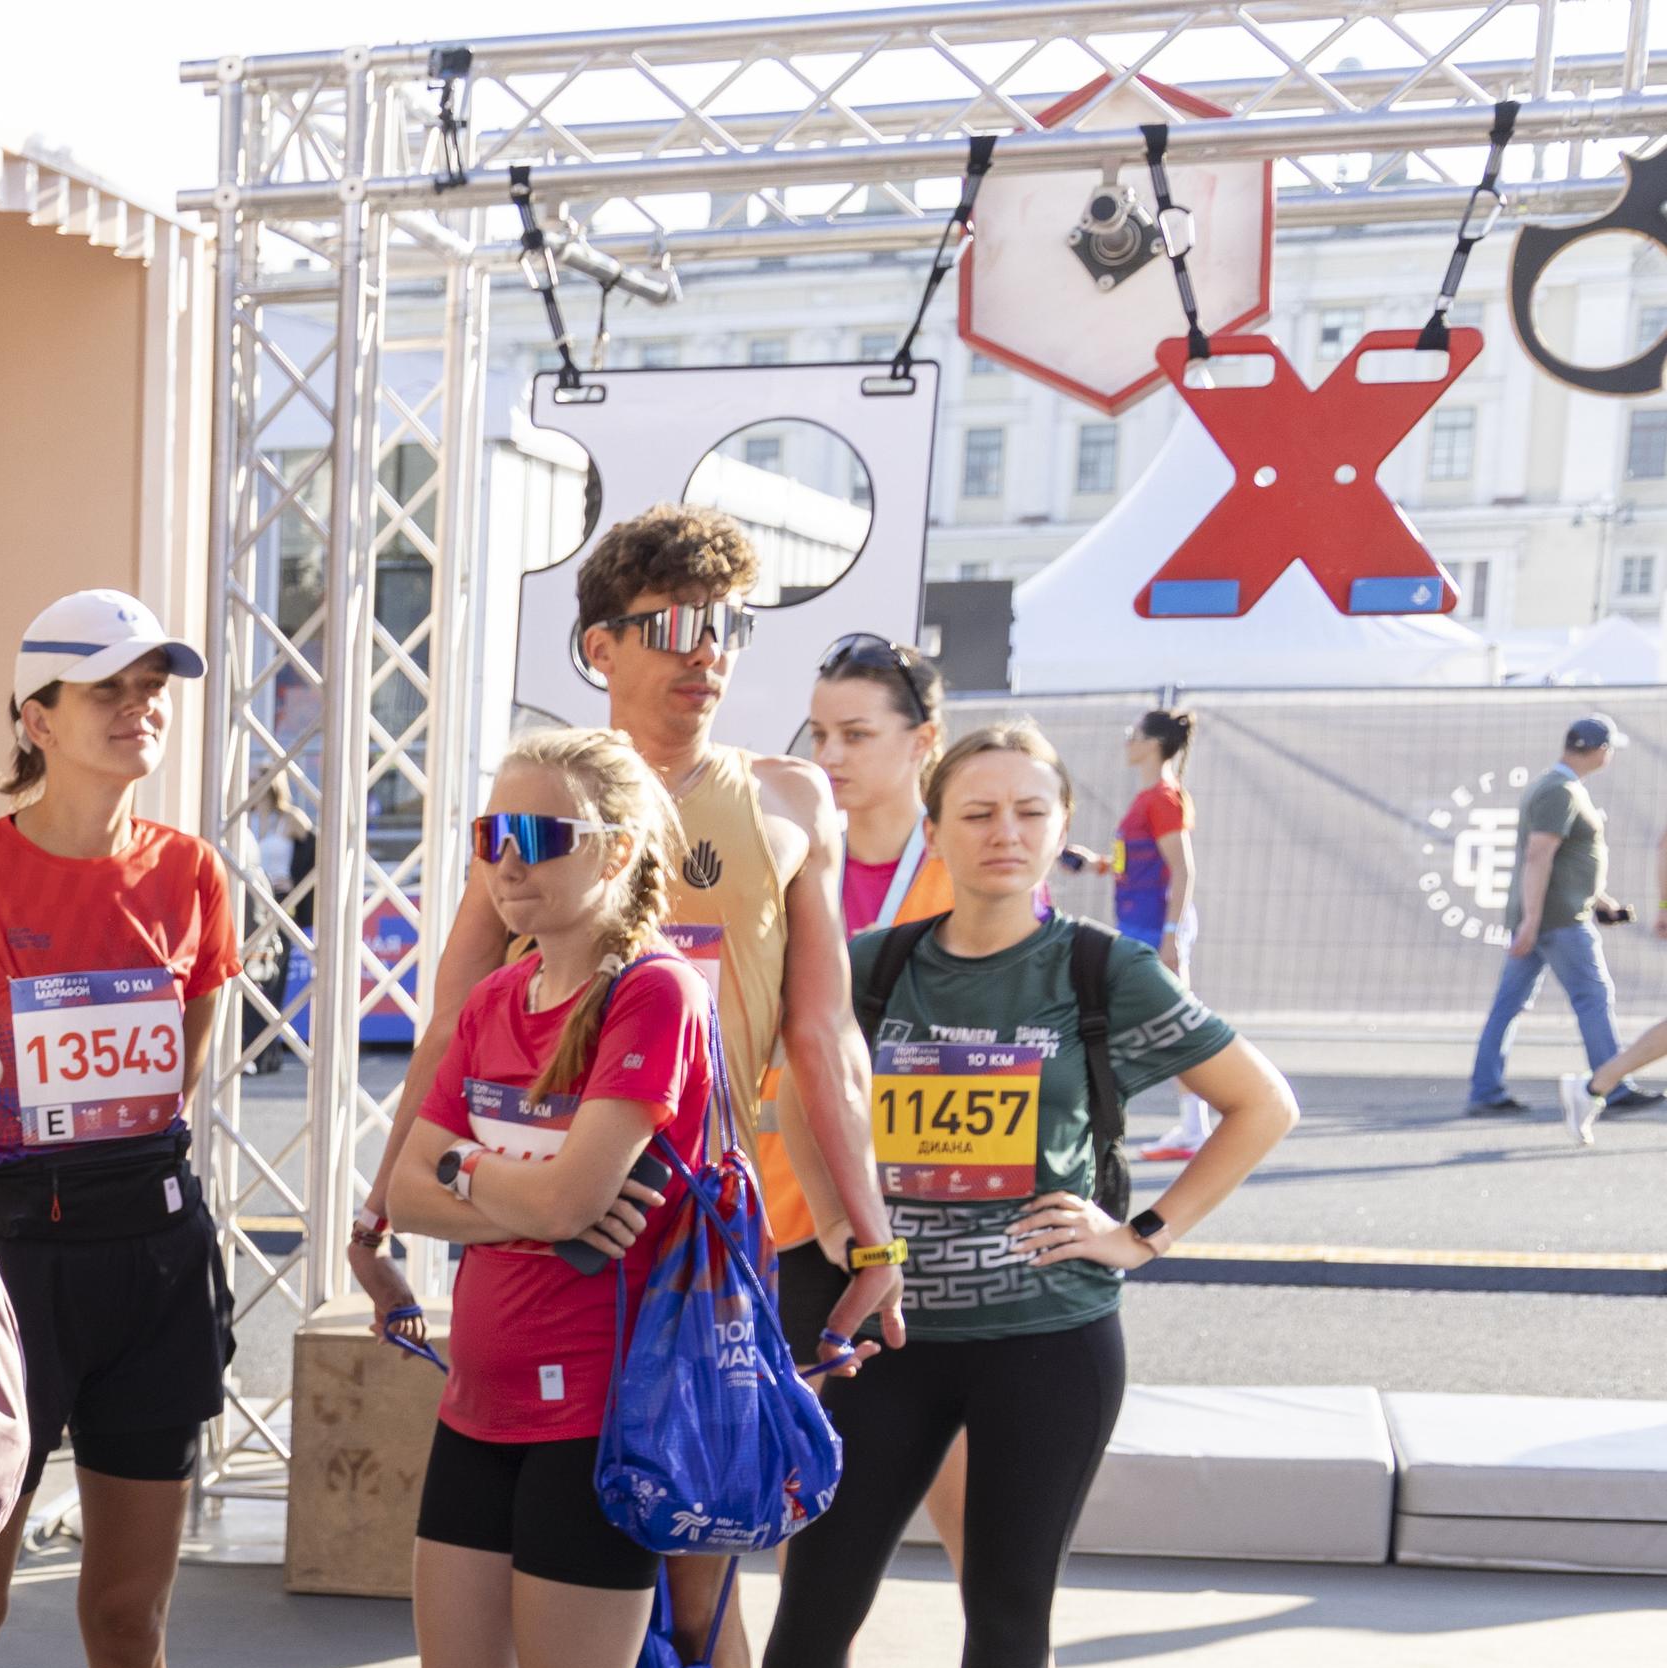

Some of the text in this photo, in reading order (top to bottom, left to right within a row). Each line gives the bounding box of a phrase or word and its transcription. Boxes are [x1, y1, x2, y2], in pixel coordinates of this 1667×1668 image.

[113, 979, 153, 994] 10 КМ
[929, 1024, 998, 1043] TYUMEN
[26, 1024, 178, 1084] 13543
[967, 1053, 1015, 1067] 10 КМ
[880, 1089, 1030, 1136] 11457
[918, 1140, 974, 1155] ДИАНА
